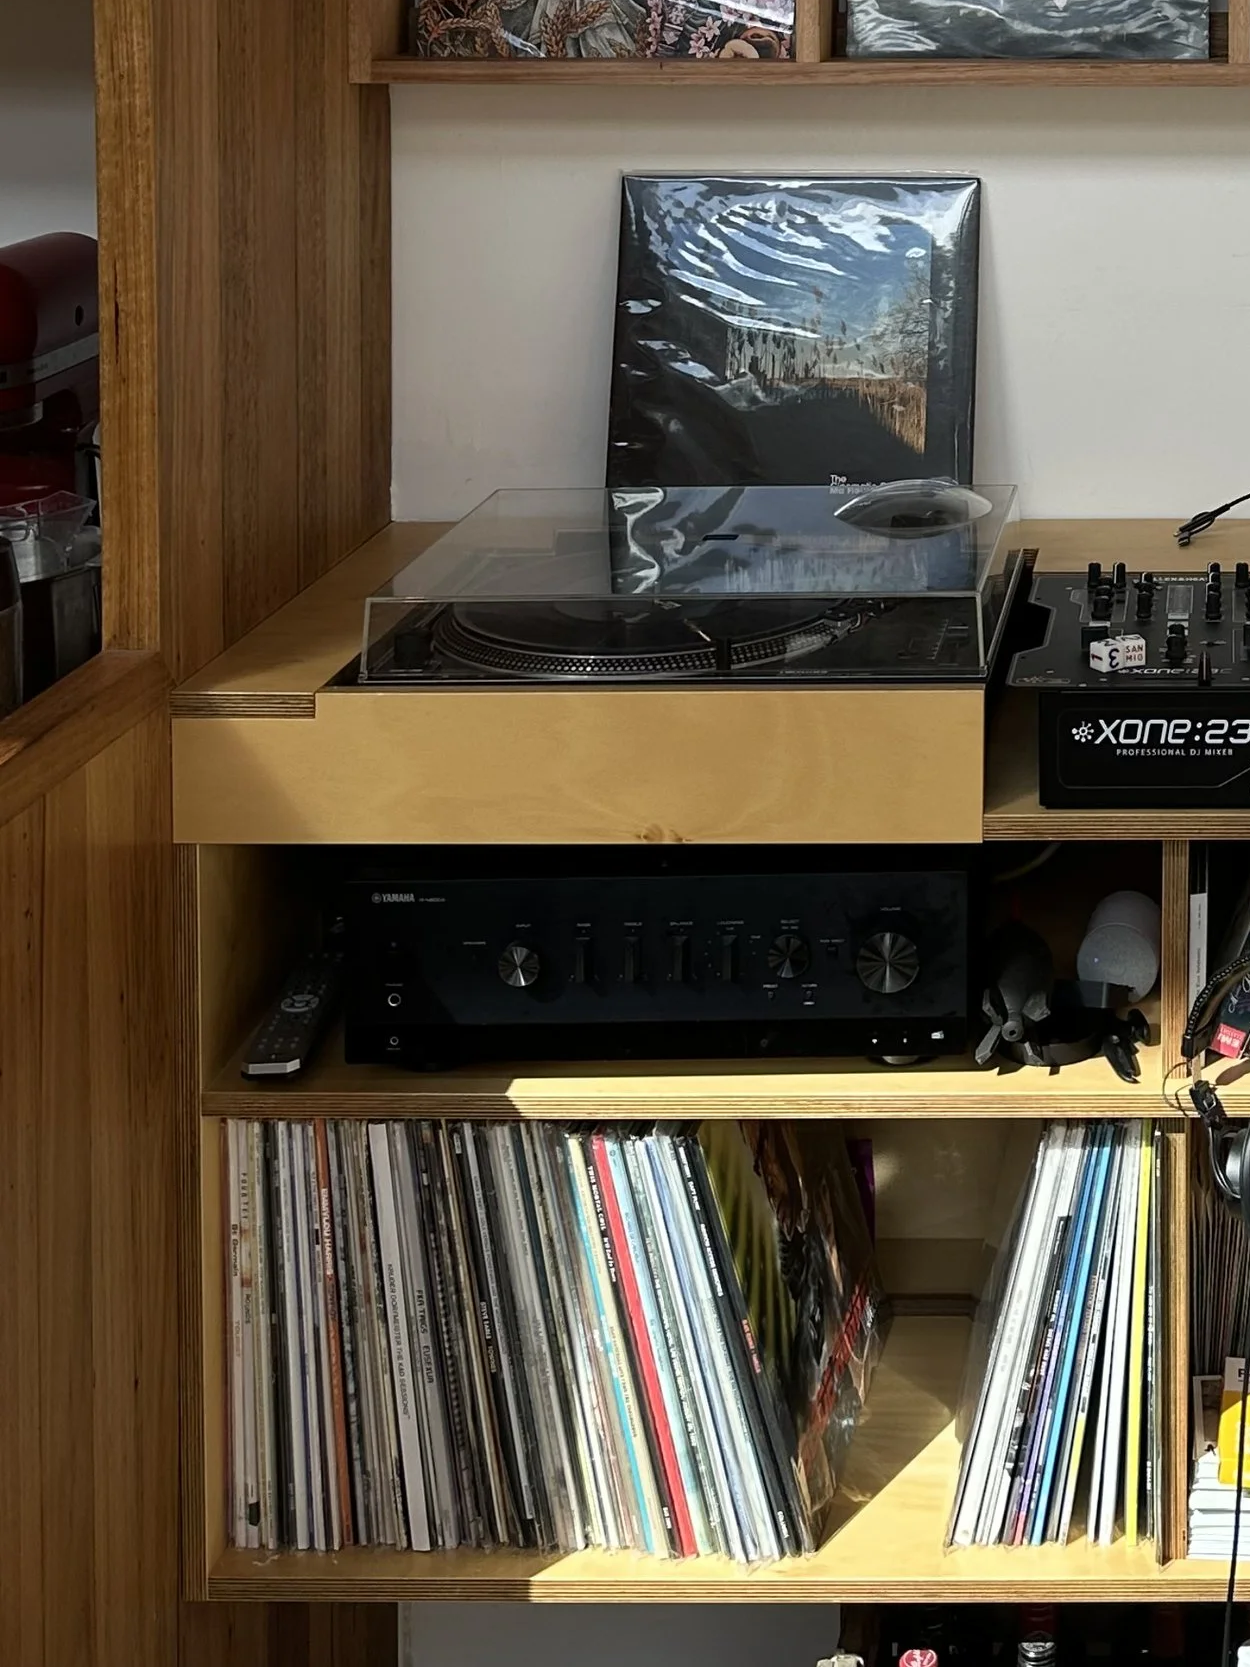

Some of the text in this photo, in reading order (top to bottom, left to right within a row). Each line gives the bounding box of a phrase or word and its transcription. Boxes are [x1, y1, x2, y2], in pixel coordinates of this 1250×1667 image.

[1125, 644, 1144, 653] SAN
[382, 893, 415, 902] YAMAHA
[587, 1166, 596, 1183] THIS
[591, 1183, 602, 1213] MORTAL
[320, 1187, 331, 1234] EMMYLOU
[232, 1238, 240, 1277] Germain
[324, 1237, 334, 1276] HARRIS
[416, 1289, 425, 1307] FKA
[480, 1301, 489, 1321] STEVE
